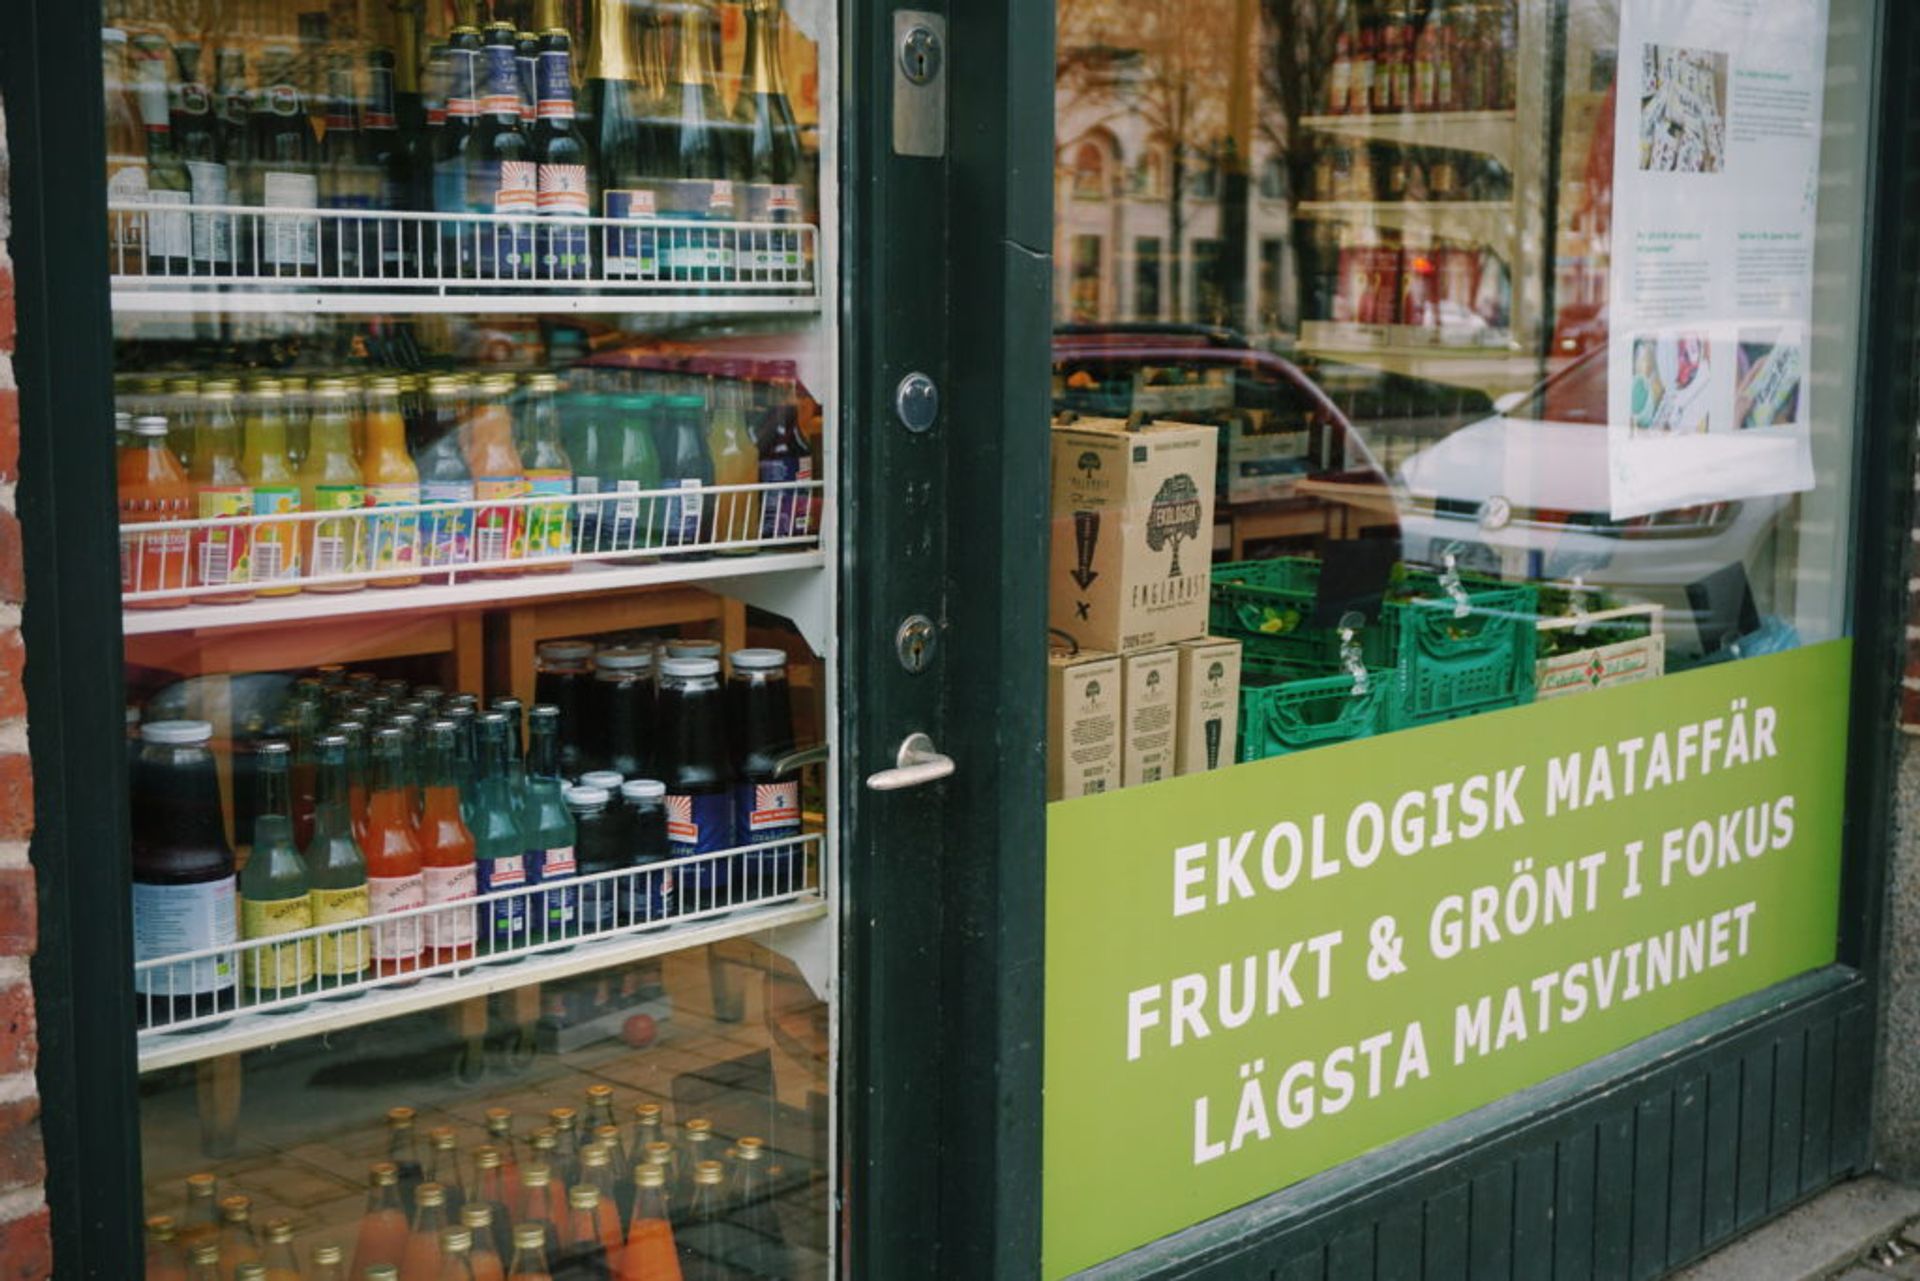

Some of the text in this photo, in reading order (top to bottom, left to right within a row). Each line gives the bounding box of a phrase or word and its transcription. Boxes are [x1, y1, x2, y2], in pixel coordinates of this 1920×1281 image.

[1132, 574, 1206, 608] ENGLAMUST
[1172, 697, 1777, 917] EKOLOGISK MATAFFÄR
[1126, 795, 1794, 1062] FRUKT & GRÖNT I FOKUS
[1192, 901, 1757, 1165] LÄGSTA MATSVINNET
